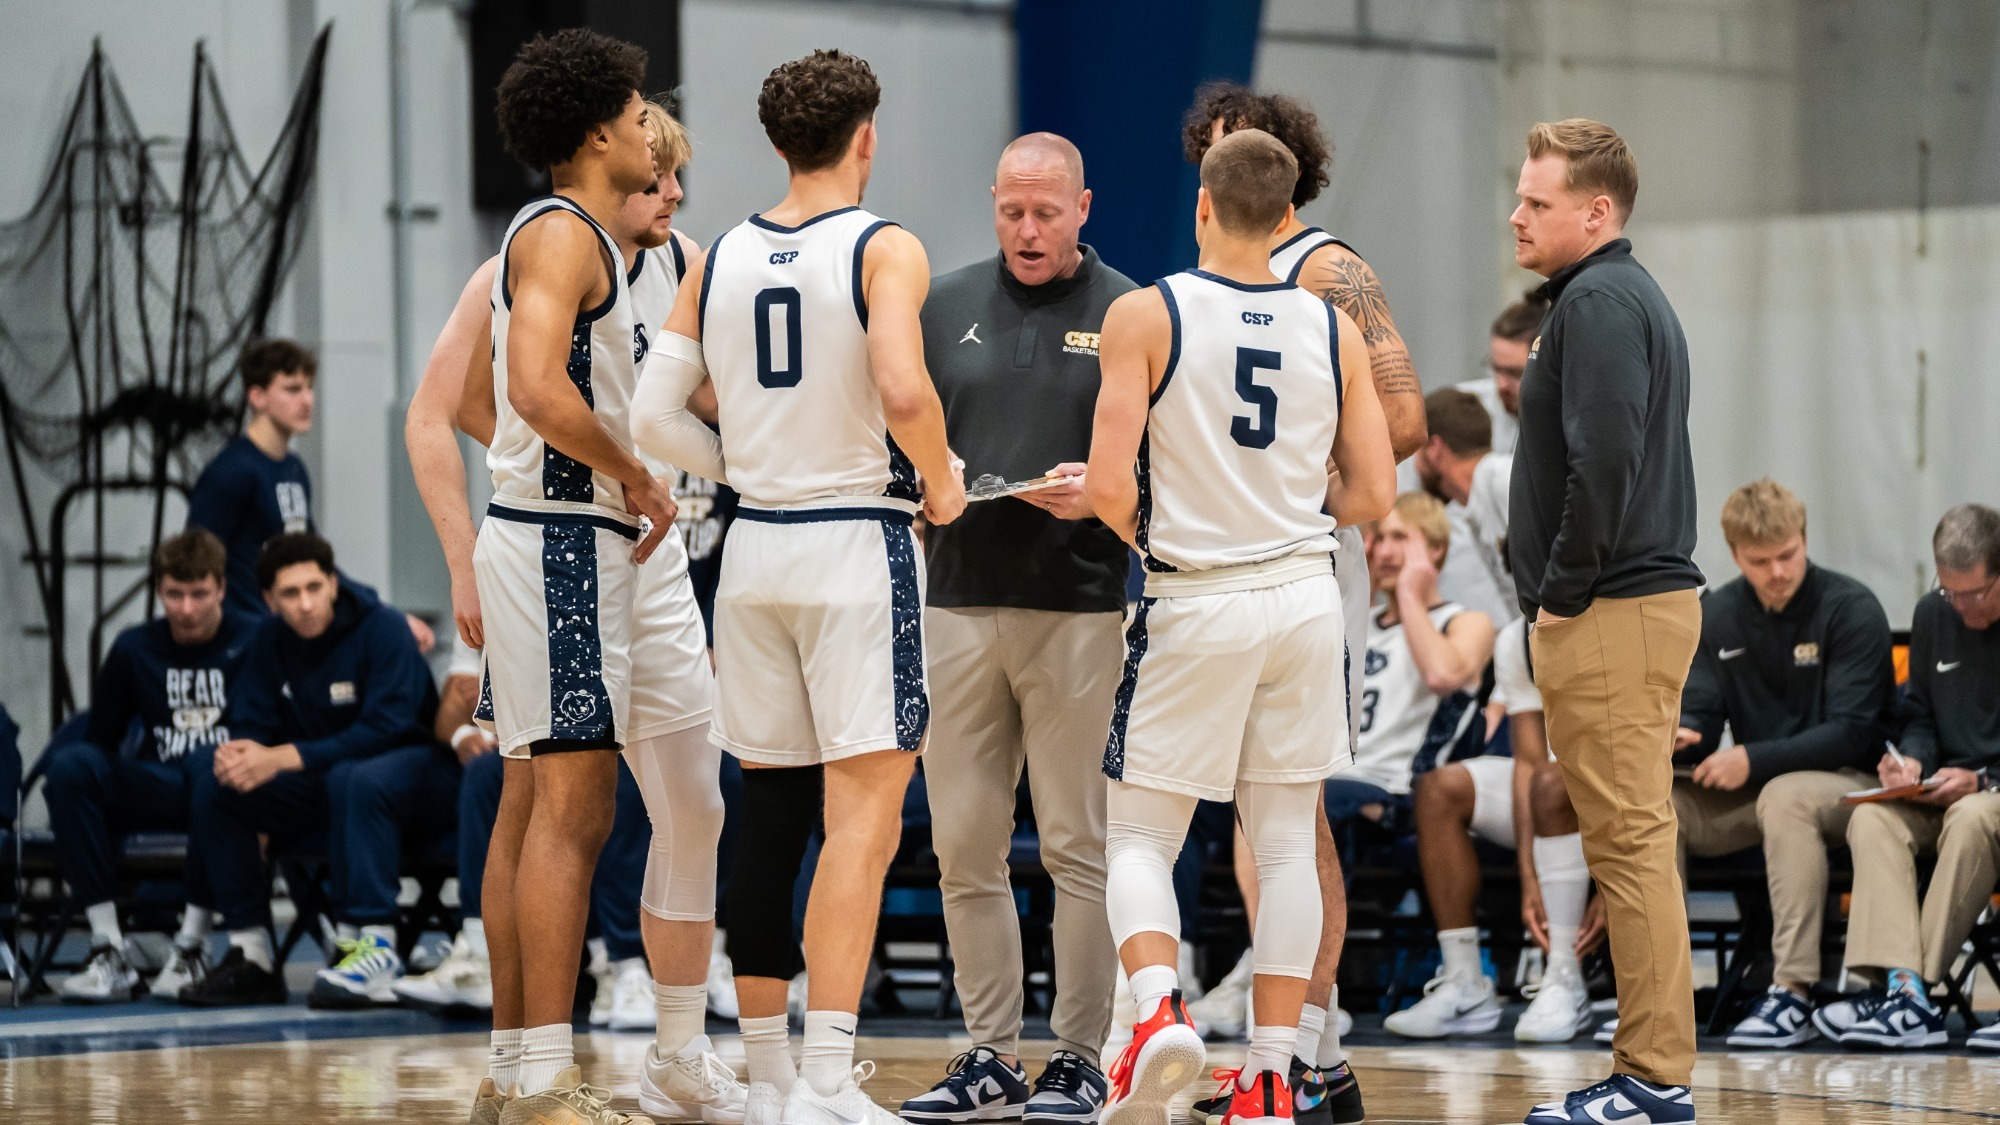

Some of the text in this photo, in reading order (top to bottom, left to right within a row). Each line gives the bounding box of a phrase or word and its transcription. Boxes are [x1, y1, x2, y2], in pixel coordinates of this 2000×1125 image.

[769, 251, 799, 265] CSP
[1241, 311, 1274, 326] CSP
[754, 287, 802, 389] 0
[1062, 346, 1100, 356] BASKETBAL
[1230, 347, 1282, 450] 5
[166, 668, 226, 708] BEAR
